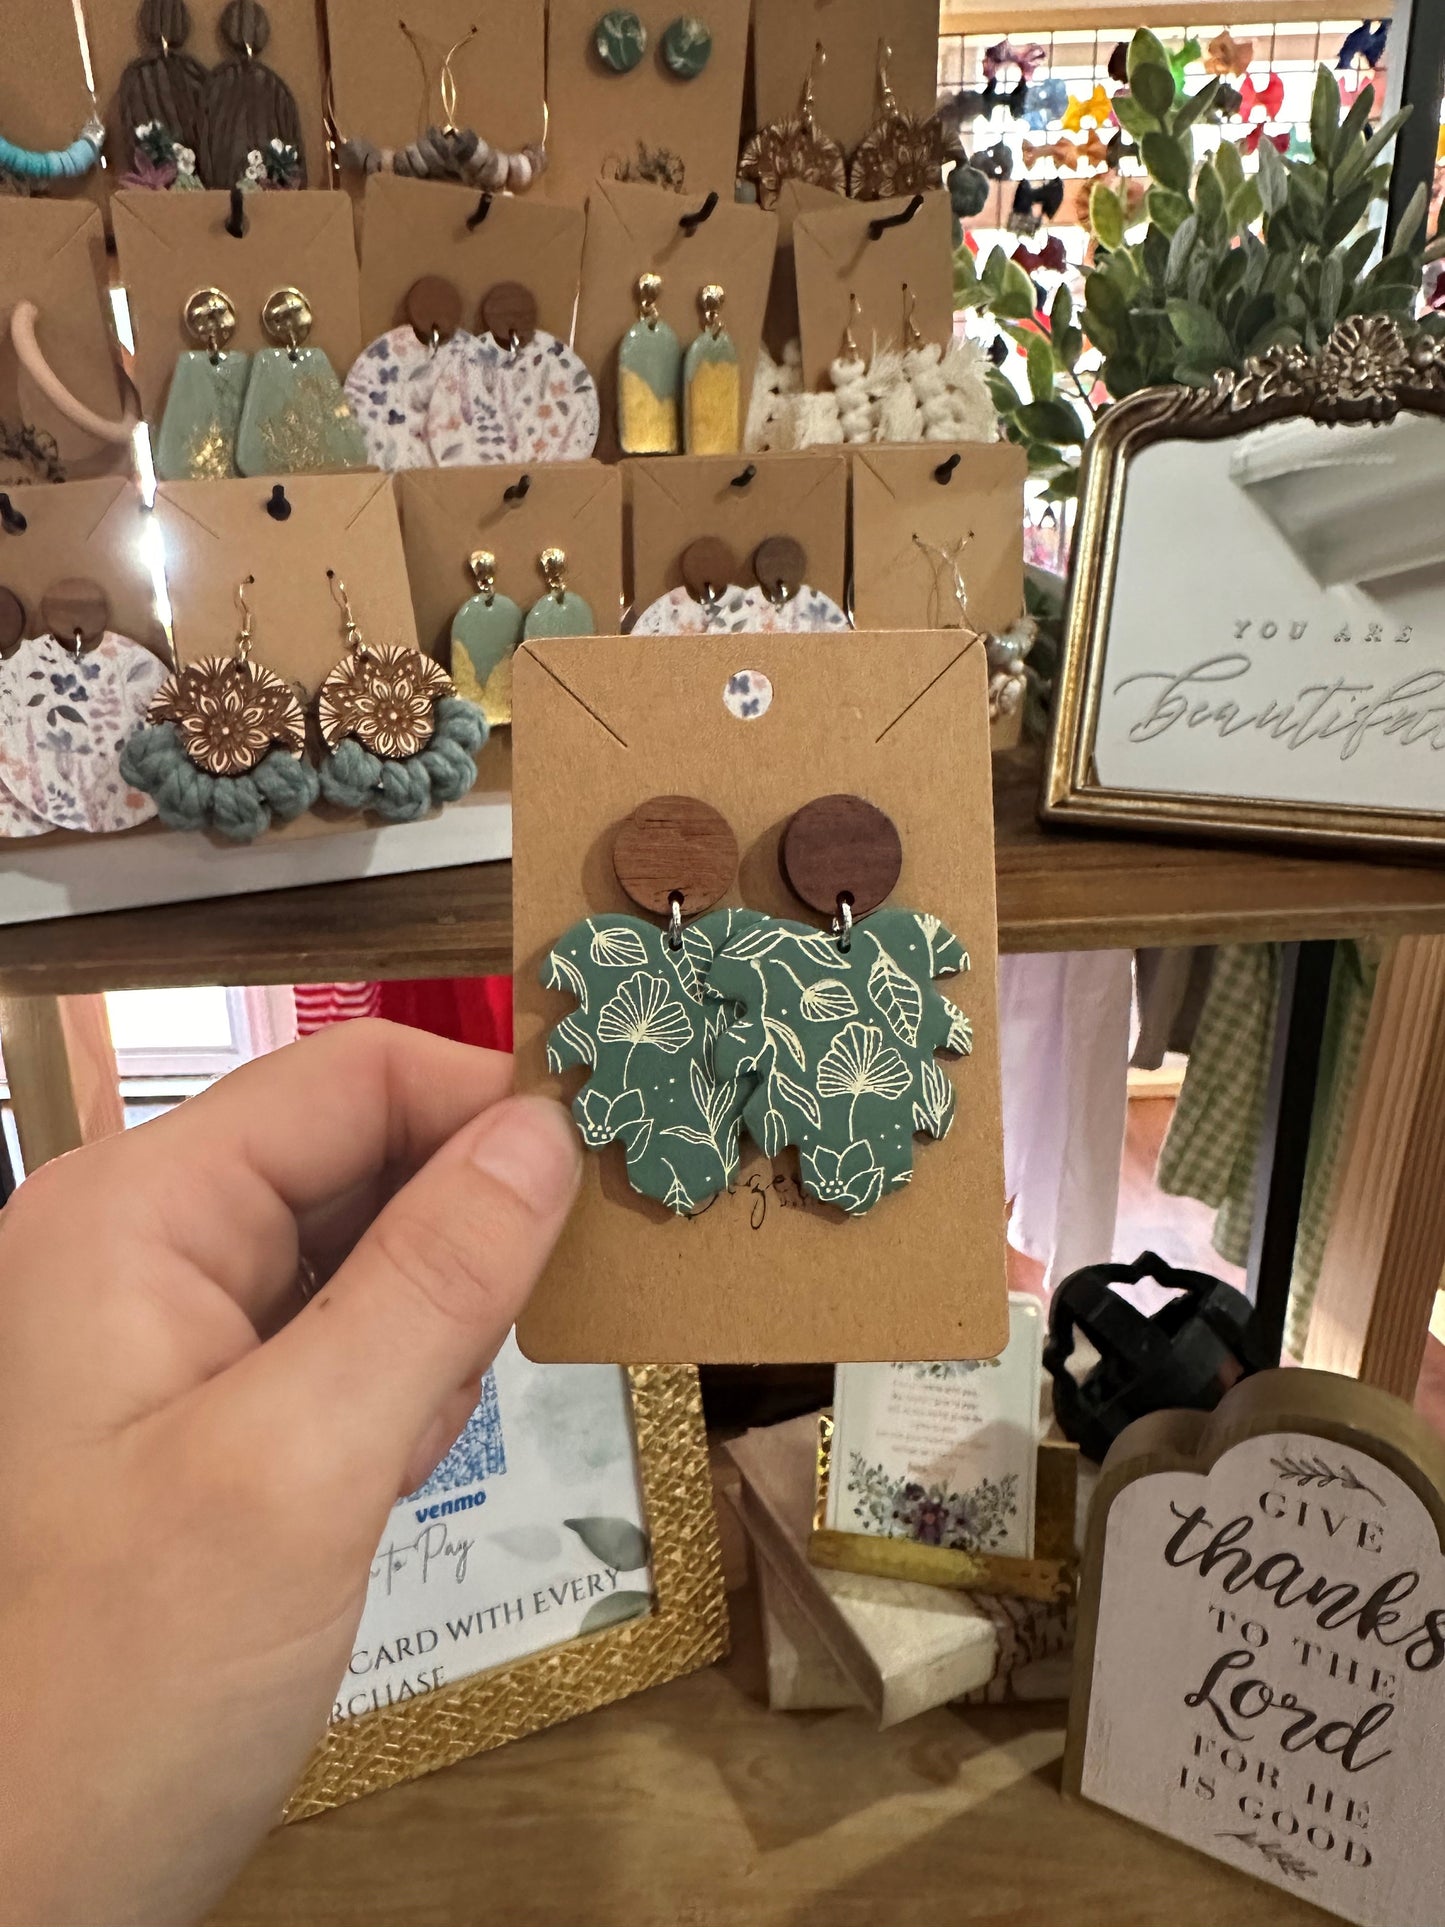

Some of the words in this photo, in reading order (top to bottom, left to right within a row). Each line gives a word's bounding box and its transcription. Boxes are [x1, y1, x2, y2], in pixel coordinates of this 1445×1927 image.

[1233, 619, 1308, 640] YOU
[1333, 621, 1413, 643] ARE
[1113, 653, 1445, 760] beautifu
[413, 1523, 475, 1584] Pay
[415, 1489, 487, 1523] venmo
[1258, 1491, 1384, 1553] GIVE
[348, 1628, 439, 1676] CARD
[445, 1597, 524, 1642] WITH
[533, 1566, 622, 1616] EVERY
[1164, 1500, 1445, 1672] thanks
[1208, 1601, 1269, 1648] TO
[1292, 1636, 1397, 1698] THE
[1184, 1650, 1395, 1773] Lord
[1179, 1765, 1216, 1801] IS
[1238, 1796, 1372, 1868] GOOD
[1193, 1734, 1280, 1789] FOR
[1306, 1783, 1370, 1829] HE
